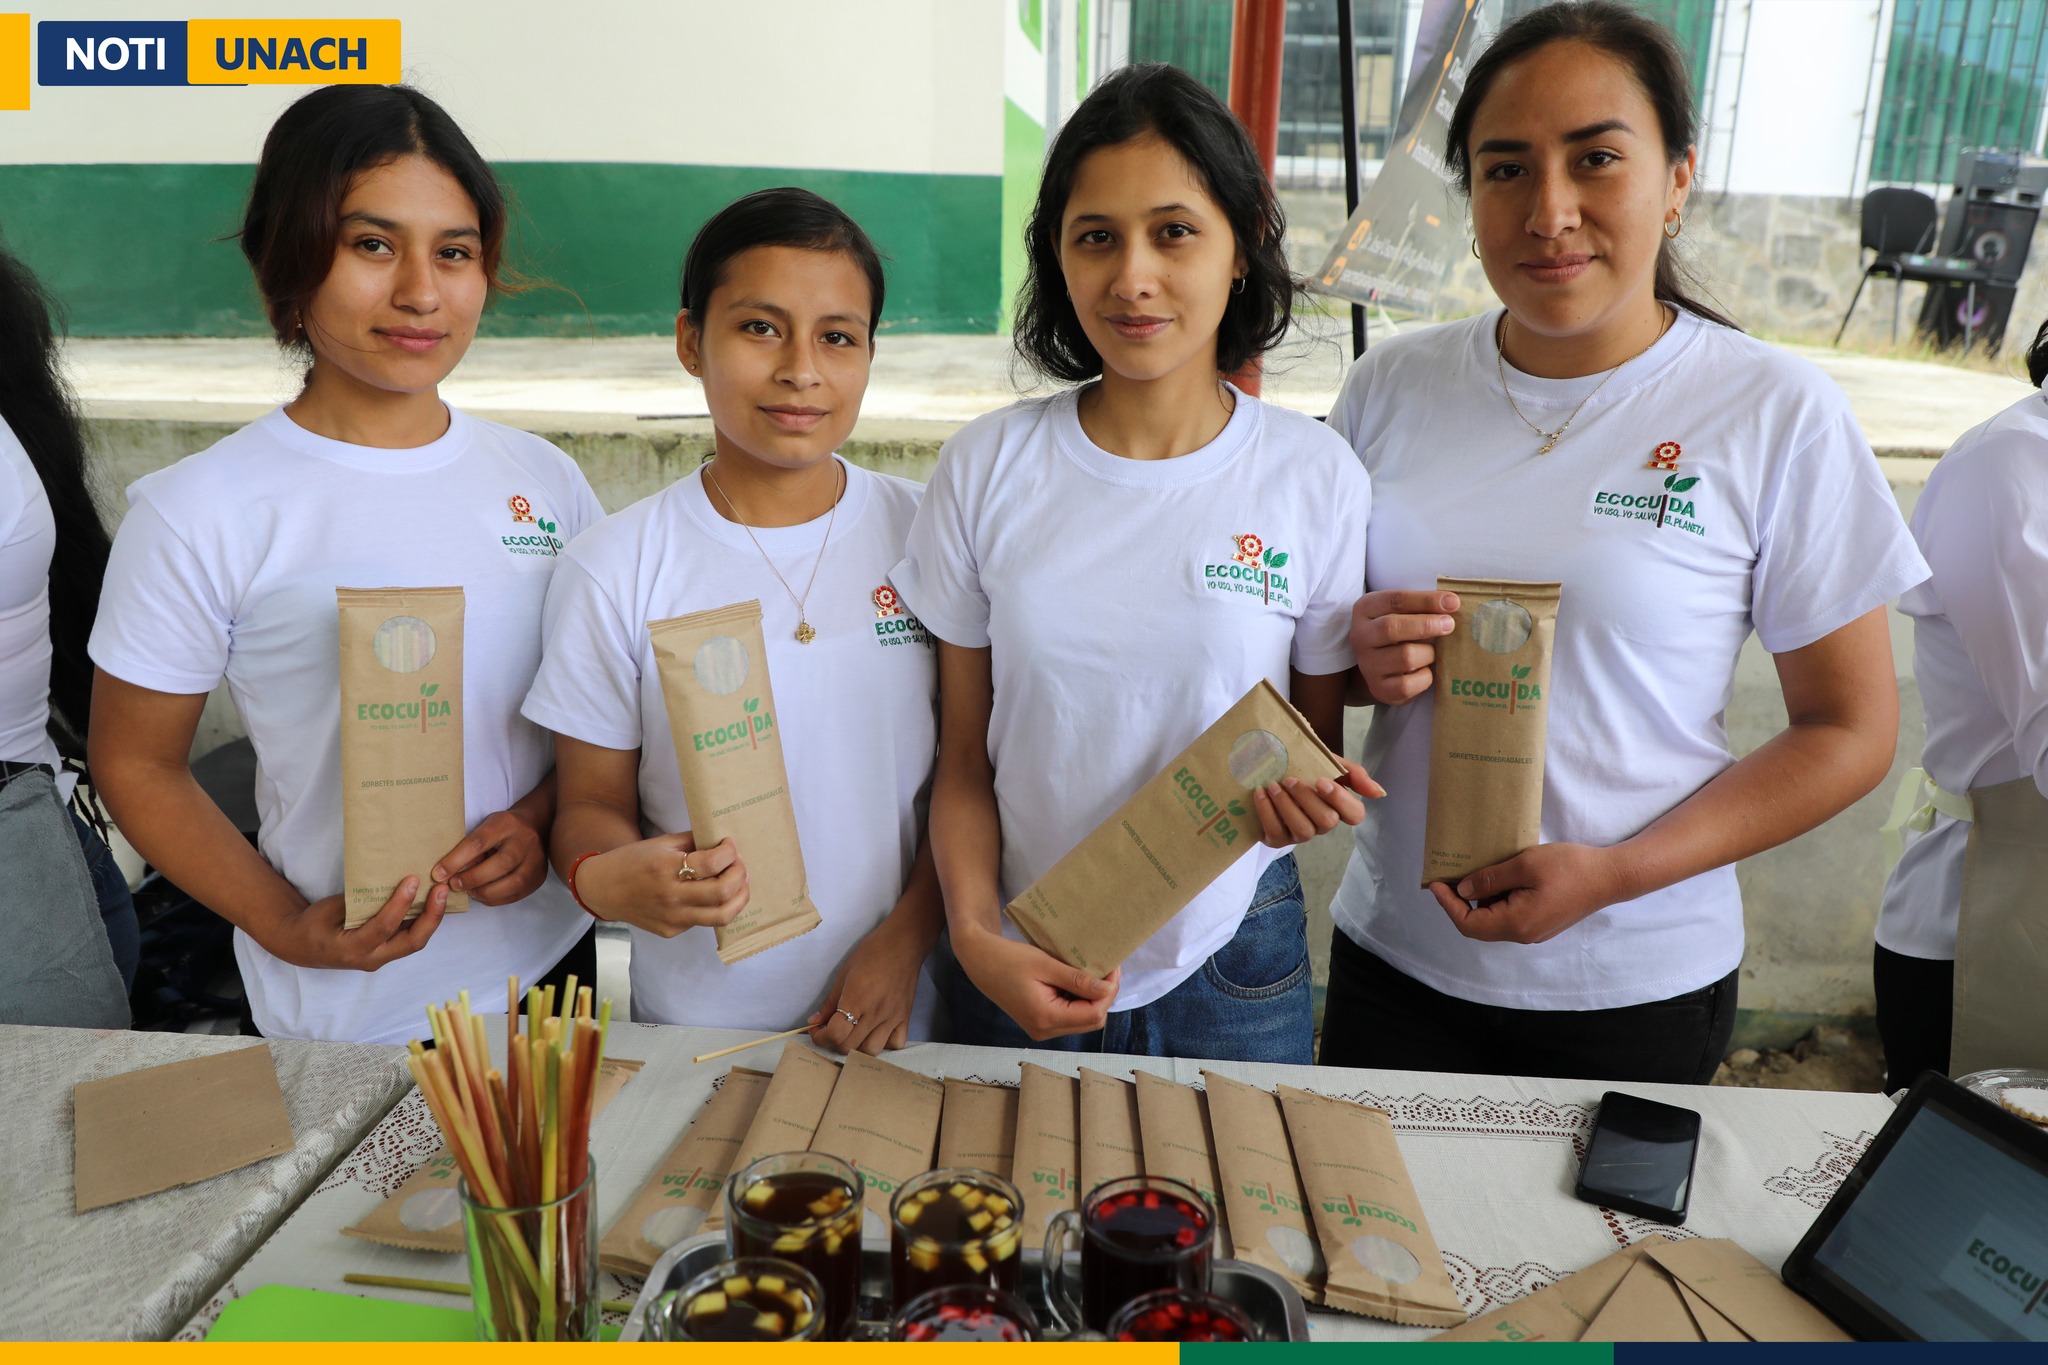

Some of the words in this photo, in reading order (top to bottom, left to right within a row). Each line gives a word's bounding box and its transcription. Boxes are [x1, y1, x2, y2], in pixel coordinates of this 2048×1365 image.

[1593, 506, 1603, 515] YO
[1622, 510, 1632, 519] YO
[1674, 517, 1705, 536] PLANETA
[1595, 491, 1695, 528] ECOCUIDA
[1205, 564, 1289, 605] ECOCUIDA
[1451, 679, 1541, 715] ECOCUIDA
[357, 699, 452, 733] ECOCUIDA
[693, 711, 773, 751] ECOCUIDA
[1448, 751, 1479, 761] SORBETES
[361, 779, 395, 788] SORBETES
[395, 774, 449, 786] BIODEGRADABLES
[1173, 766, 1239, 846] ECOCUIDA
[352, 886, 374, 894] Hecho
[1322, 1194, 1418, 1233] ECOCUIDA
